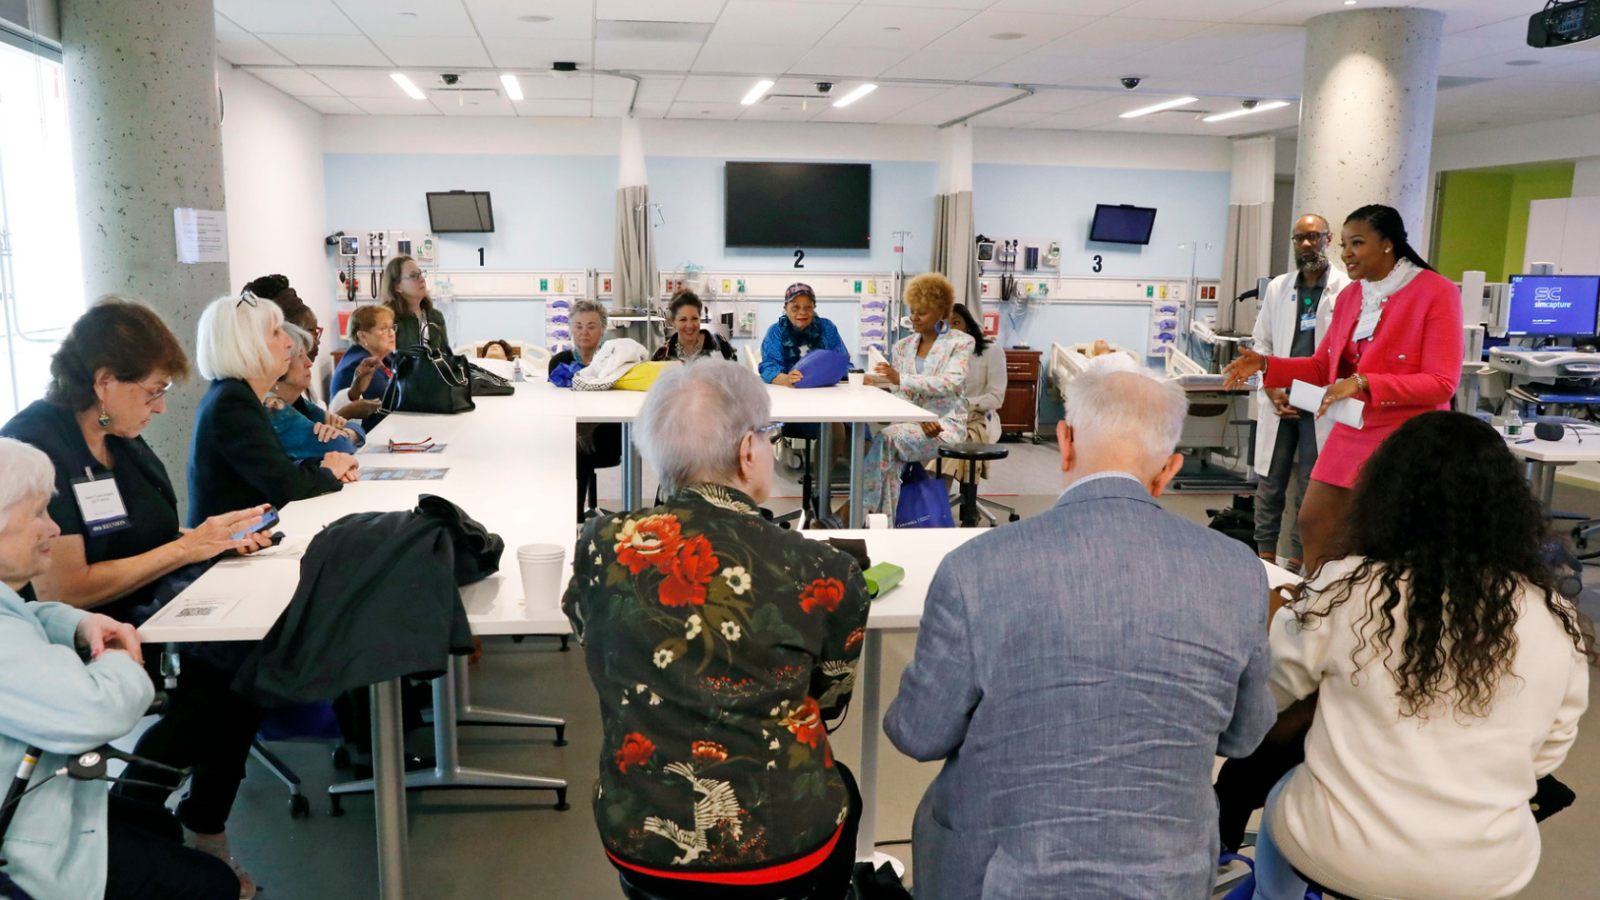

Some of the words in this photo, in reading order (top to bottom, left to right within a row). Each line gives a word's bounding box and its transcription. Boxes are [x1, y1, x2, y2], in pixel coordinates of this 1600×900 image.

[477, 247, 484, 266] 1
[793, 250, 805, 268] 2
[1092, 254, 1103, 273] 3
[1534, 287, 1561, 300] SC
[1534, 300, 1572, 309] simcapture
[102, 520, 126, 529] REUNION
